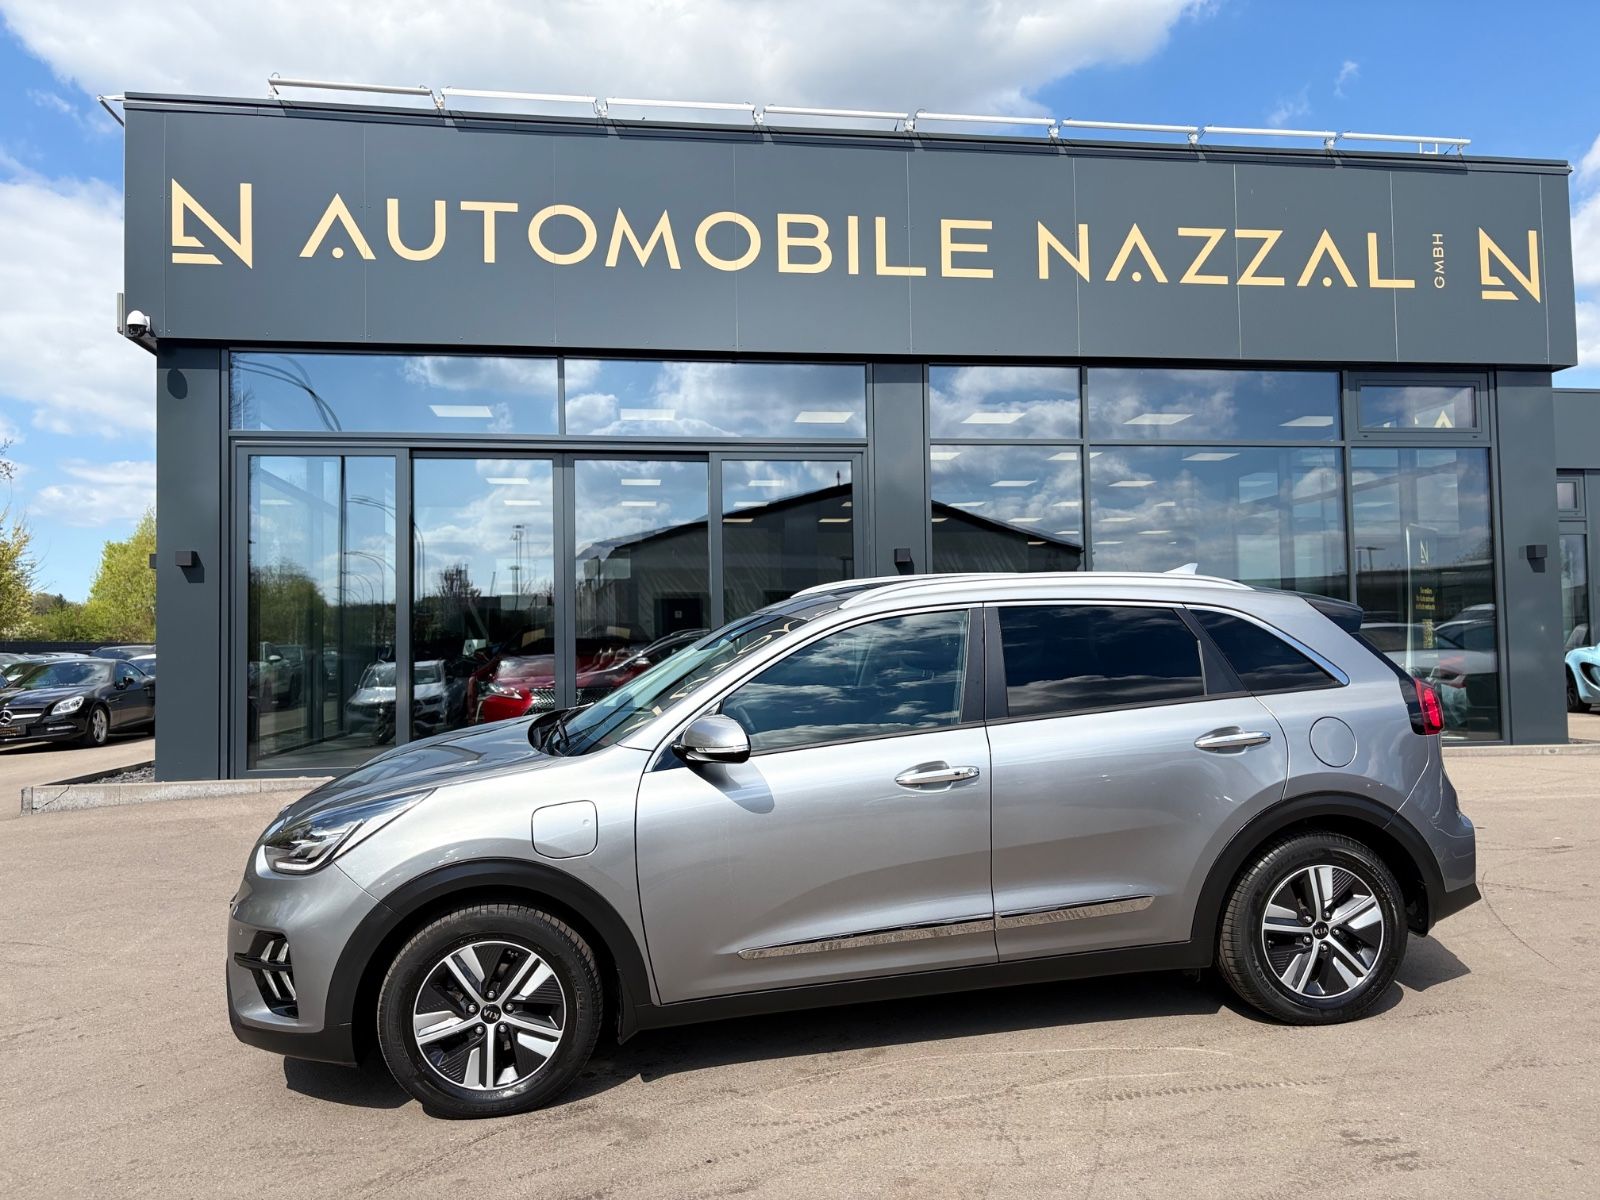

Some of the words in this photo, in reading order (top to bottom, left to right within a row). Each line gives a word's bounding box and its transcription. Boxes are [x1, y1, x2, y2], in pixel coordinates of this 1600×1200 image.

[299, 193, 994, 280] AUTOMOBILE
[1036, 221, 1416, 290] NAZZAL
[1432, 233, 1445, 289] GMBH
[1314, 927, 1328, 936] KIA
[483, 1008, 500, 1020] KIA
